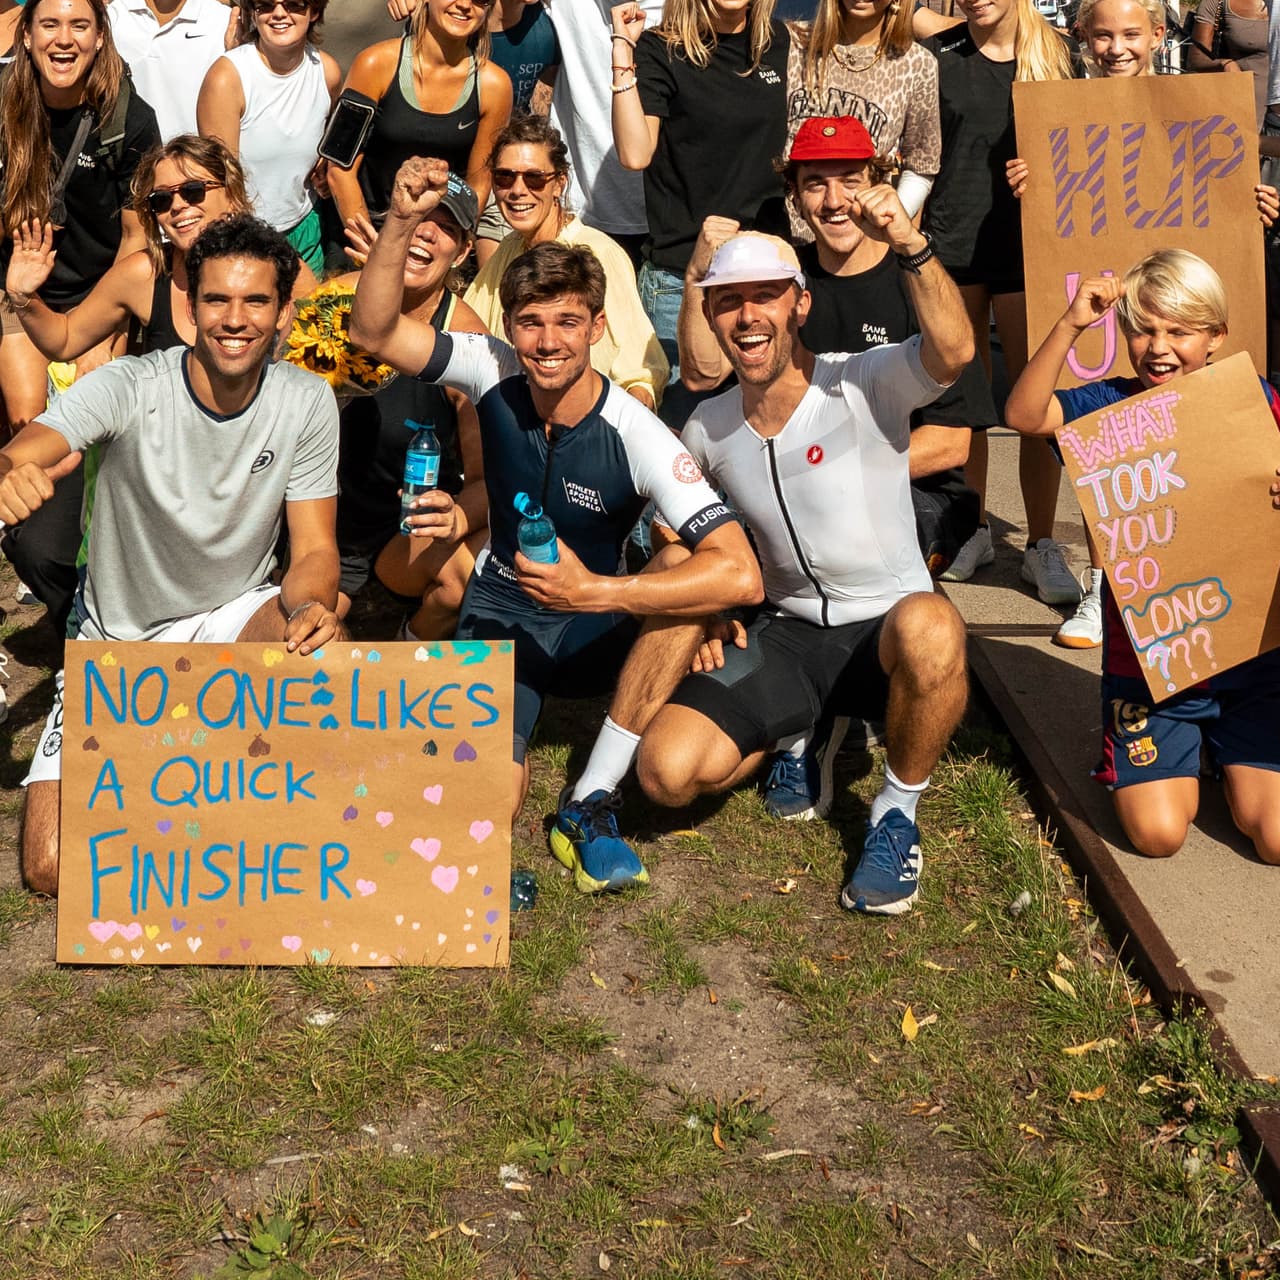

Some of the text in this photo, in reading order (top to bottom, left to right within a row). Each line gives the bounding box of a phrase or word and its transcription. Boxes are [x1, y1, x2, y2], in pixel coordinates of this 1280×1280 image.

[1047, 114, 1246, 239] HUP
[862, 323, 887, 336] BANG
[865, 333, 889, 345] BANG
[1060, 392, 1182, 471] WHAT
[566, 481, 596, 498] ATHLETE
[569, 488, 599, 505] SPORTS
[570, 495, 601, 512] WORLD
[1075, 449, 1186, 518] TOOK
[687, 504, 731, 534] FUSIO
[1096, 508, 1174, 561] YOU
[1113, 556, 1161, 601] SO
[1123, 583, 1222, 649] LONG
[83, 659, 501, 731] NO ONE LIKES
[87, 755, 317, 811] A QUICK
[87, 827, 354, 920] FINISHER
